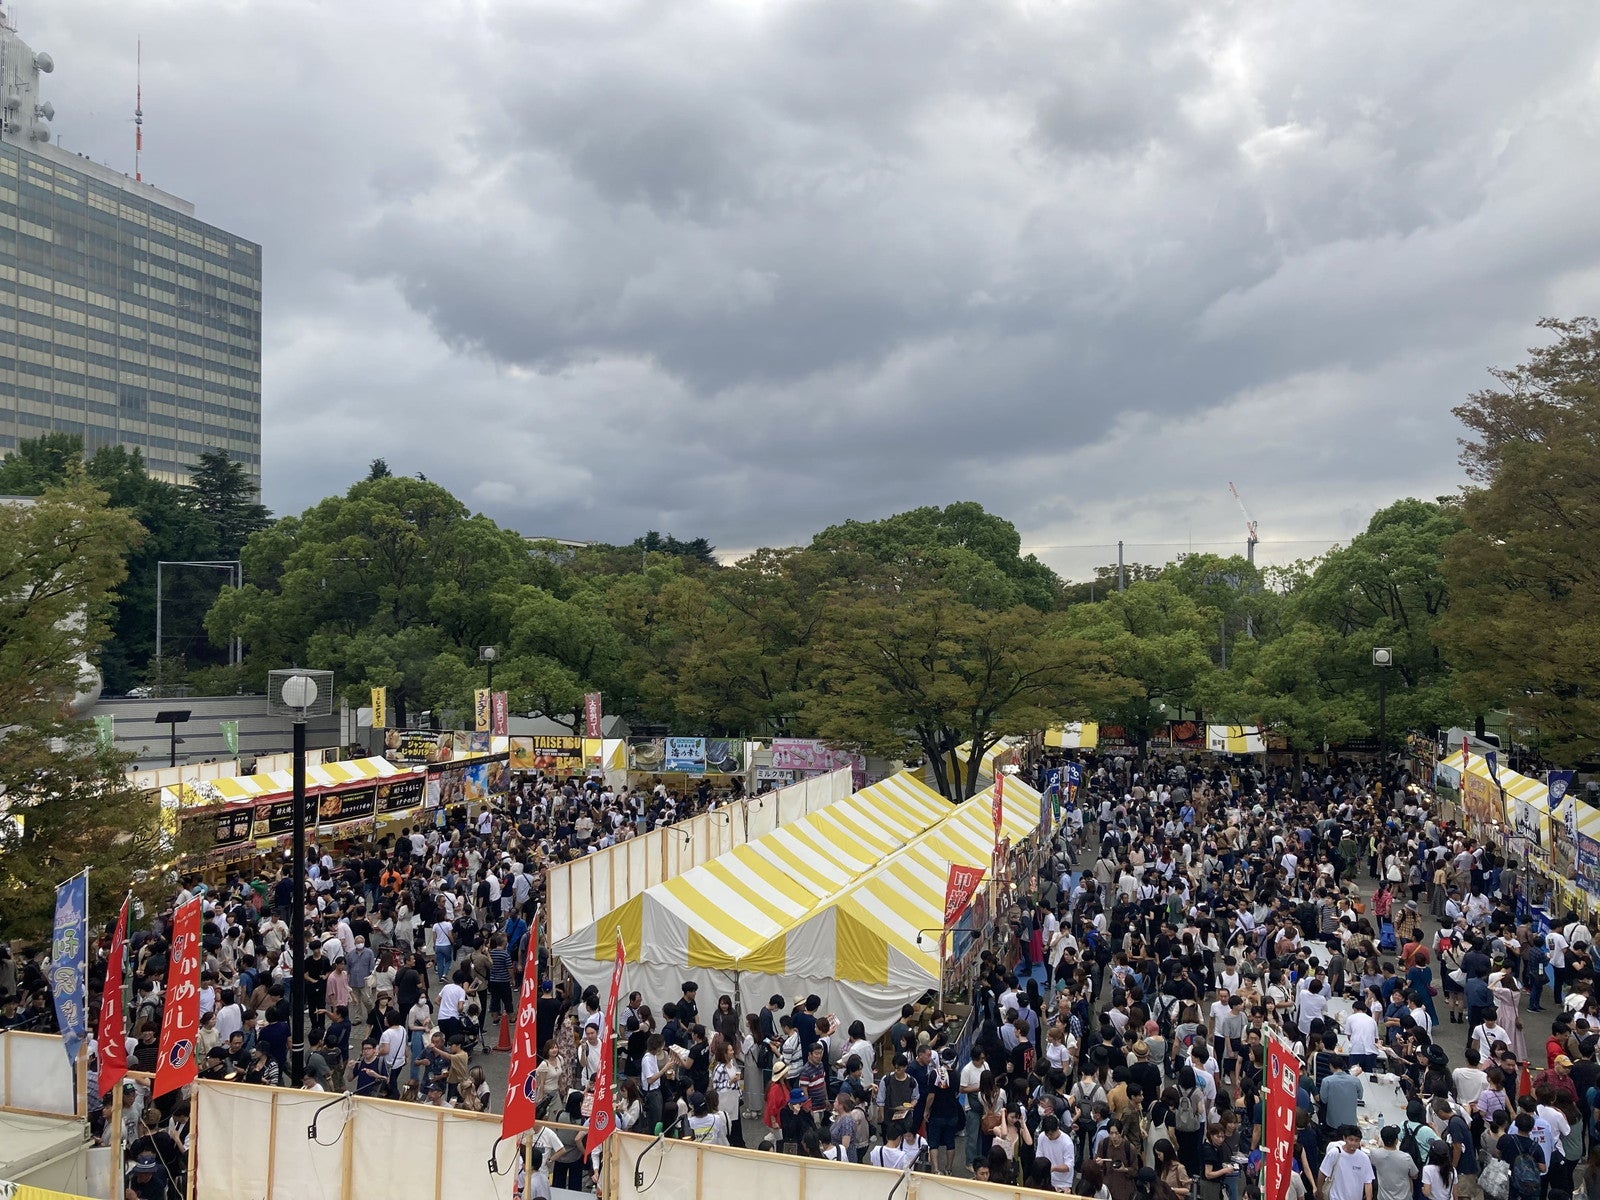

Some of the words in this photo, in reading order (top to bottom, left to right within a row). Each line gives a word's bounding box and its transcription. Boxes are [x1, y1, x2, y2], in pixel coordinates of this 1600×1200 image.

[534, 736, 581, 749] TAISETSU
[401, 748, 435, 756] じゃがバター
[757, 769, 793, 779] ミルク専門
[174, 932, 199, 1030] いかめし
[156, 984, 179, 1074] コロッケ
